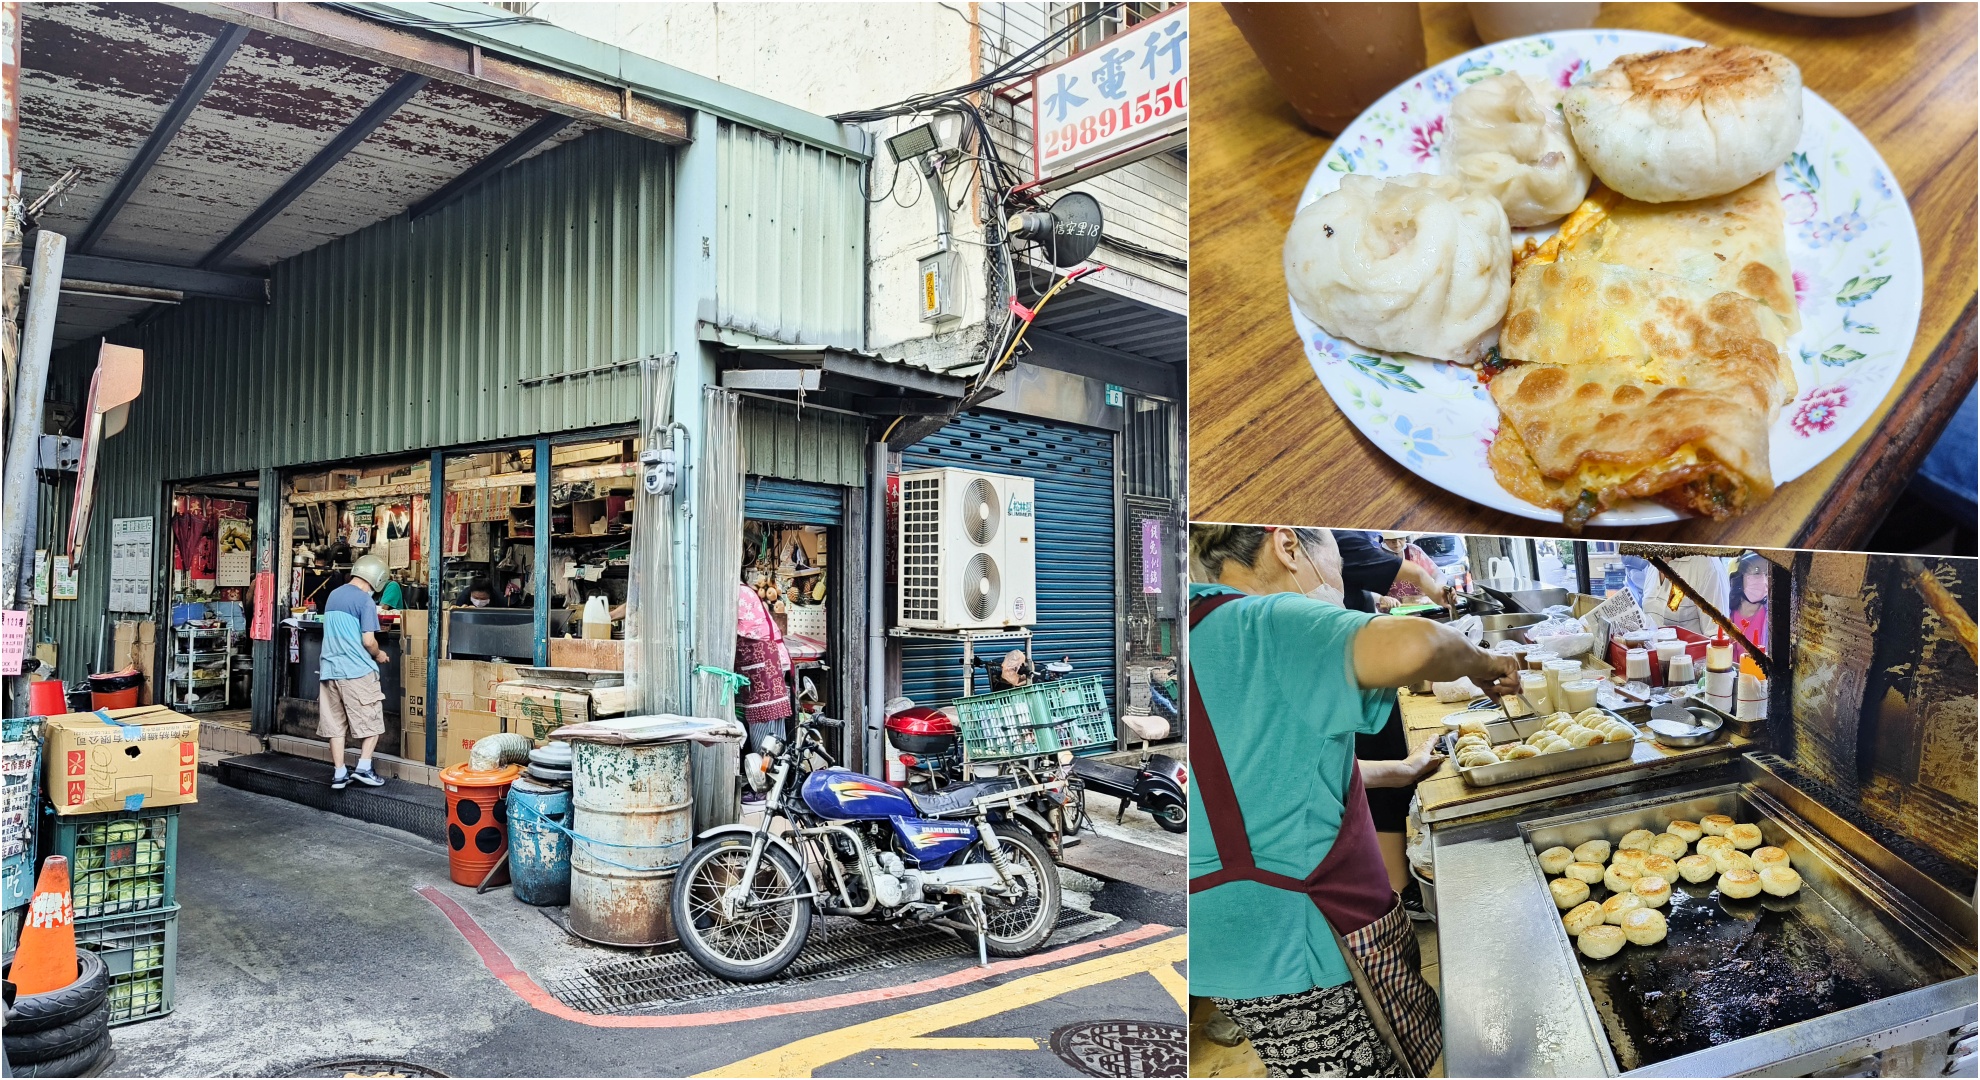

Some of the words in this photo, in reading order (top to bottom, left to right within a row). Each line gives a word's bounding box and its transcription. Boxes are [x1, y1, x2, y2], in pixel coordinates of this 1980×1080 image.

[1043, 20, 1187, 122] 水電行
[1044, 76, 1187, 159] 29891550
